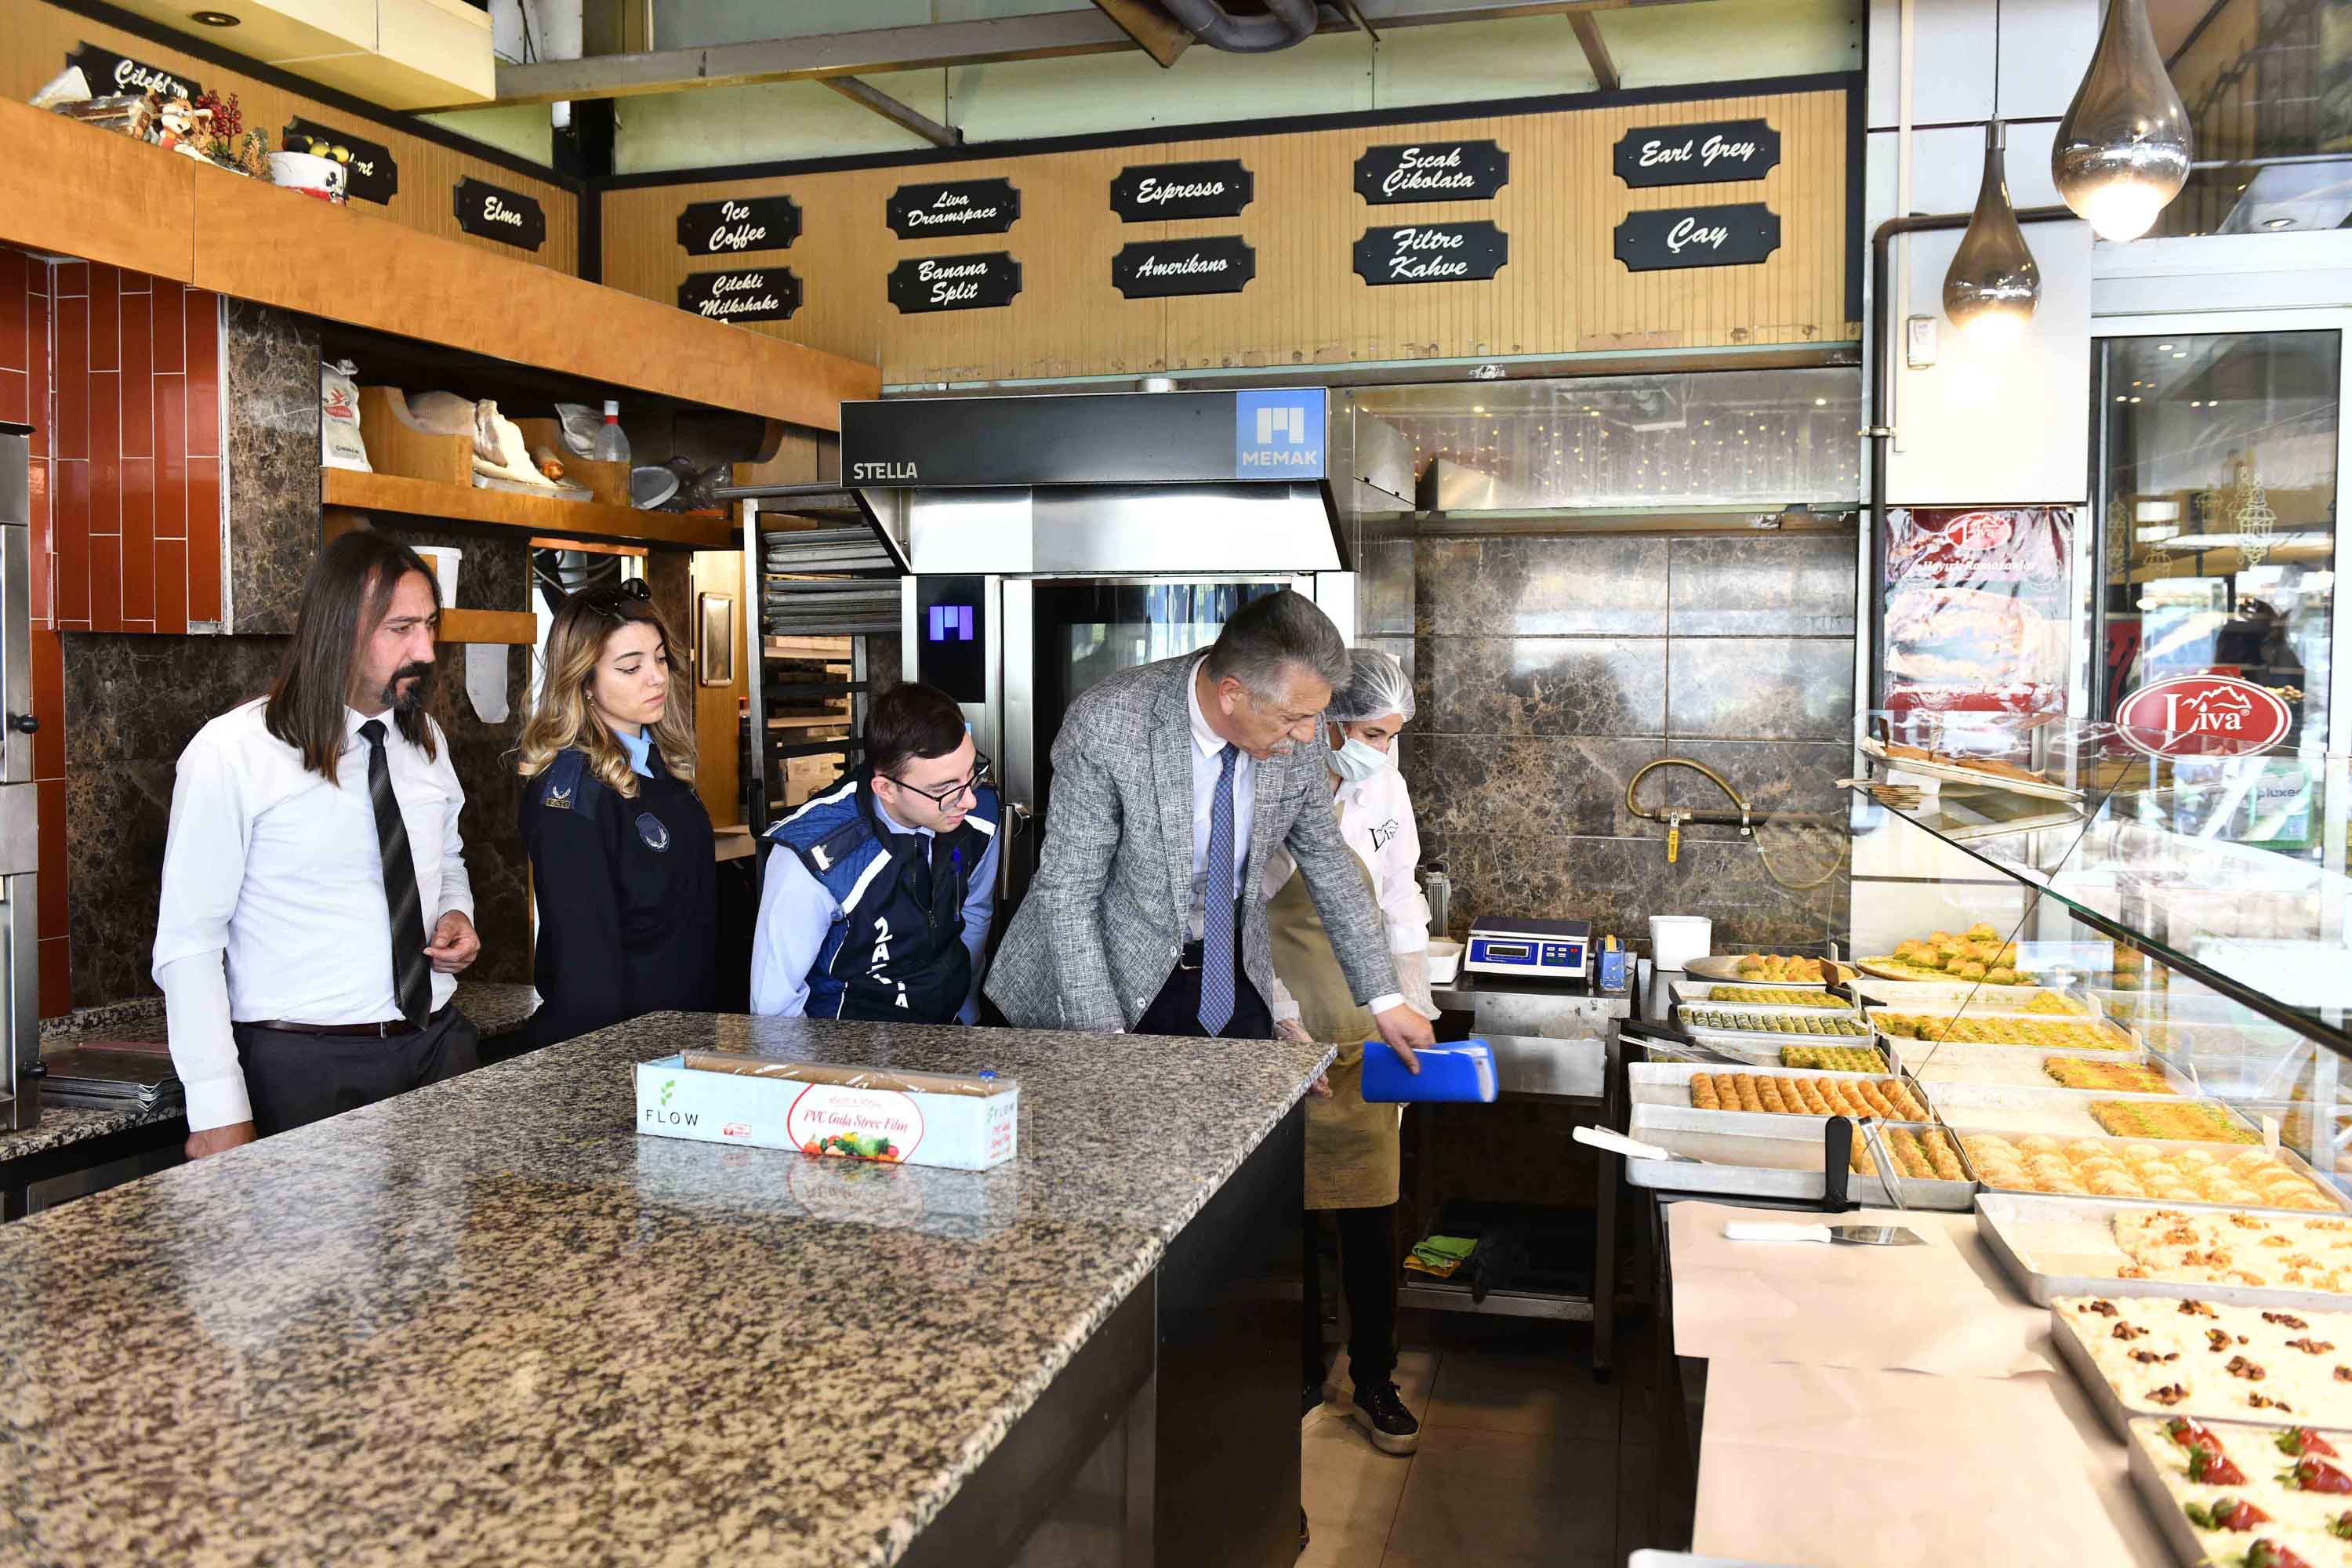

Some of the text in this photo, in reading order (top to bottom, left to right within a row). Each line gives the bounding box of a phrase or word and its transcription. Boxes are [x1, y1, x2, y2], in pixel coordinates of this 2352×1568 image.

[1398, 147, 1462, 169] Sıcak
[1639, 134, 1756, 168] Earl Grey
[1136, 177, 1225, 205] Espresso
[1382, 169, 1475, 197] Çikolata
[483, 195, 523, 227] Elma
[721, 201, 750, 223] Ice
[932, 191, 970, 209] Liva
[907, 207, 997, 227] Dreamspace
[709, 223, 767, 251] Coffee
[1392, 227, 1465, 256] Filtre
[1667, 216, 1729, 254] Çay
[918, 260, 989, 282] Banana
[1135, 252, 1229, 279] Amerikano
[1388, 255, 1468, 279] Kahve
[712, 273, 764, 298] Çilekli
[930, 281, 979, 307] Split
[699, 294, 779, 317] Milkshake
[1241, 450, 1319, 466] MEMAK
[853, 462, 919, 480] STELLA
[646, 1109, 699, 1127] FLOW
